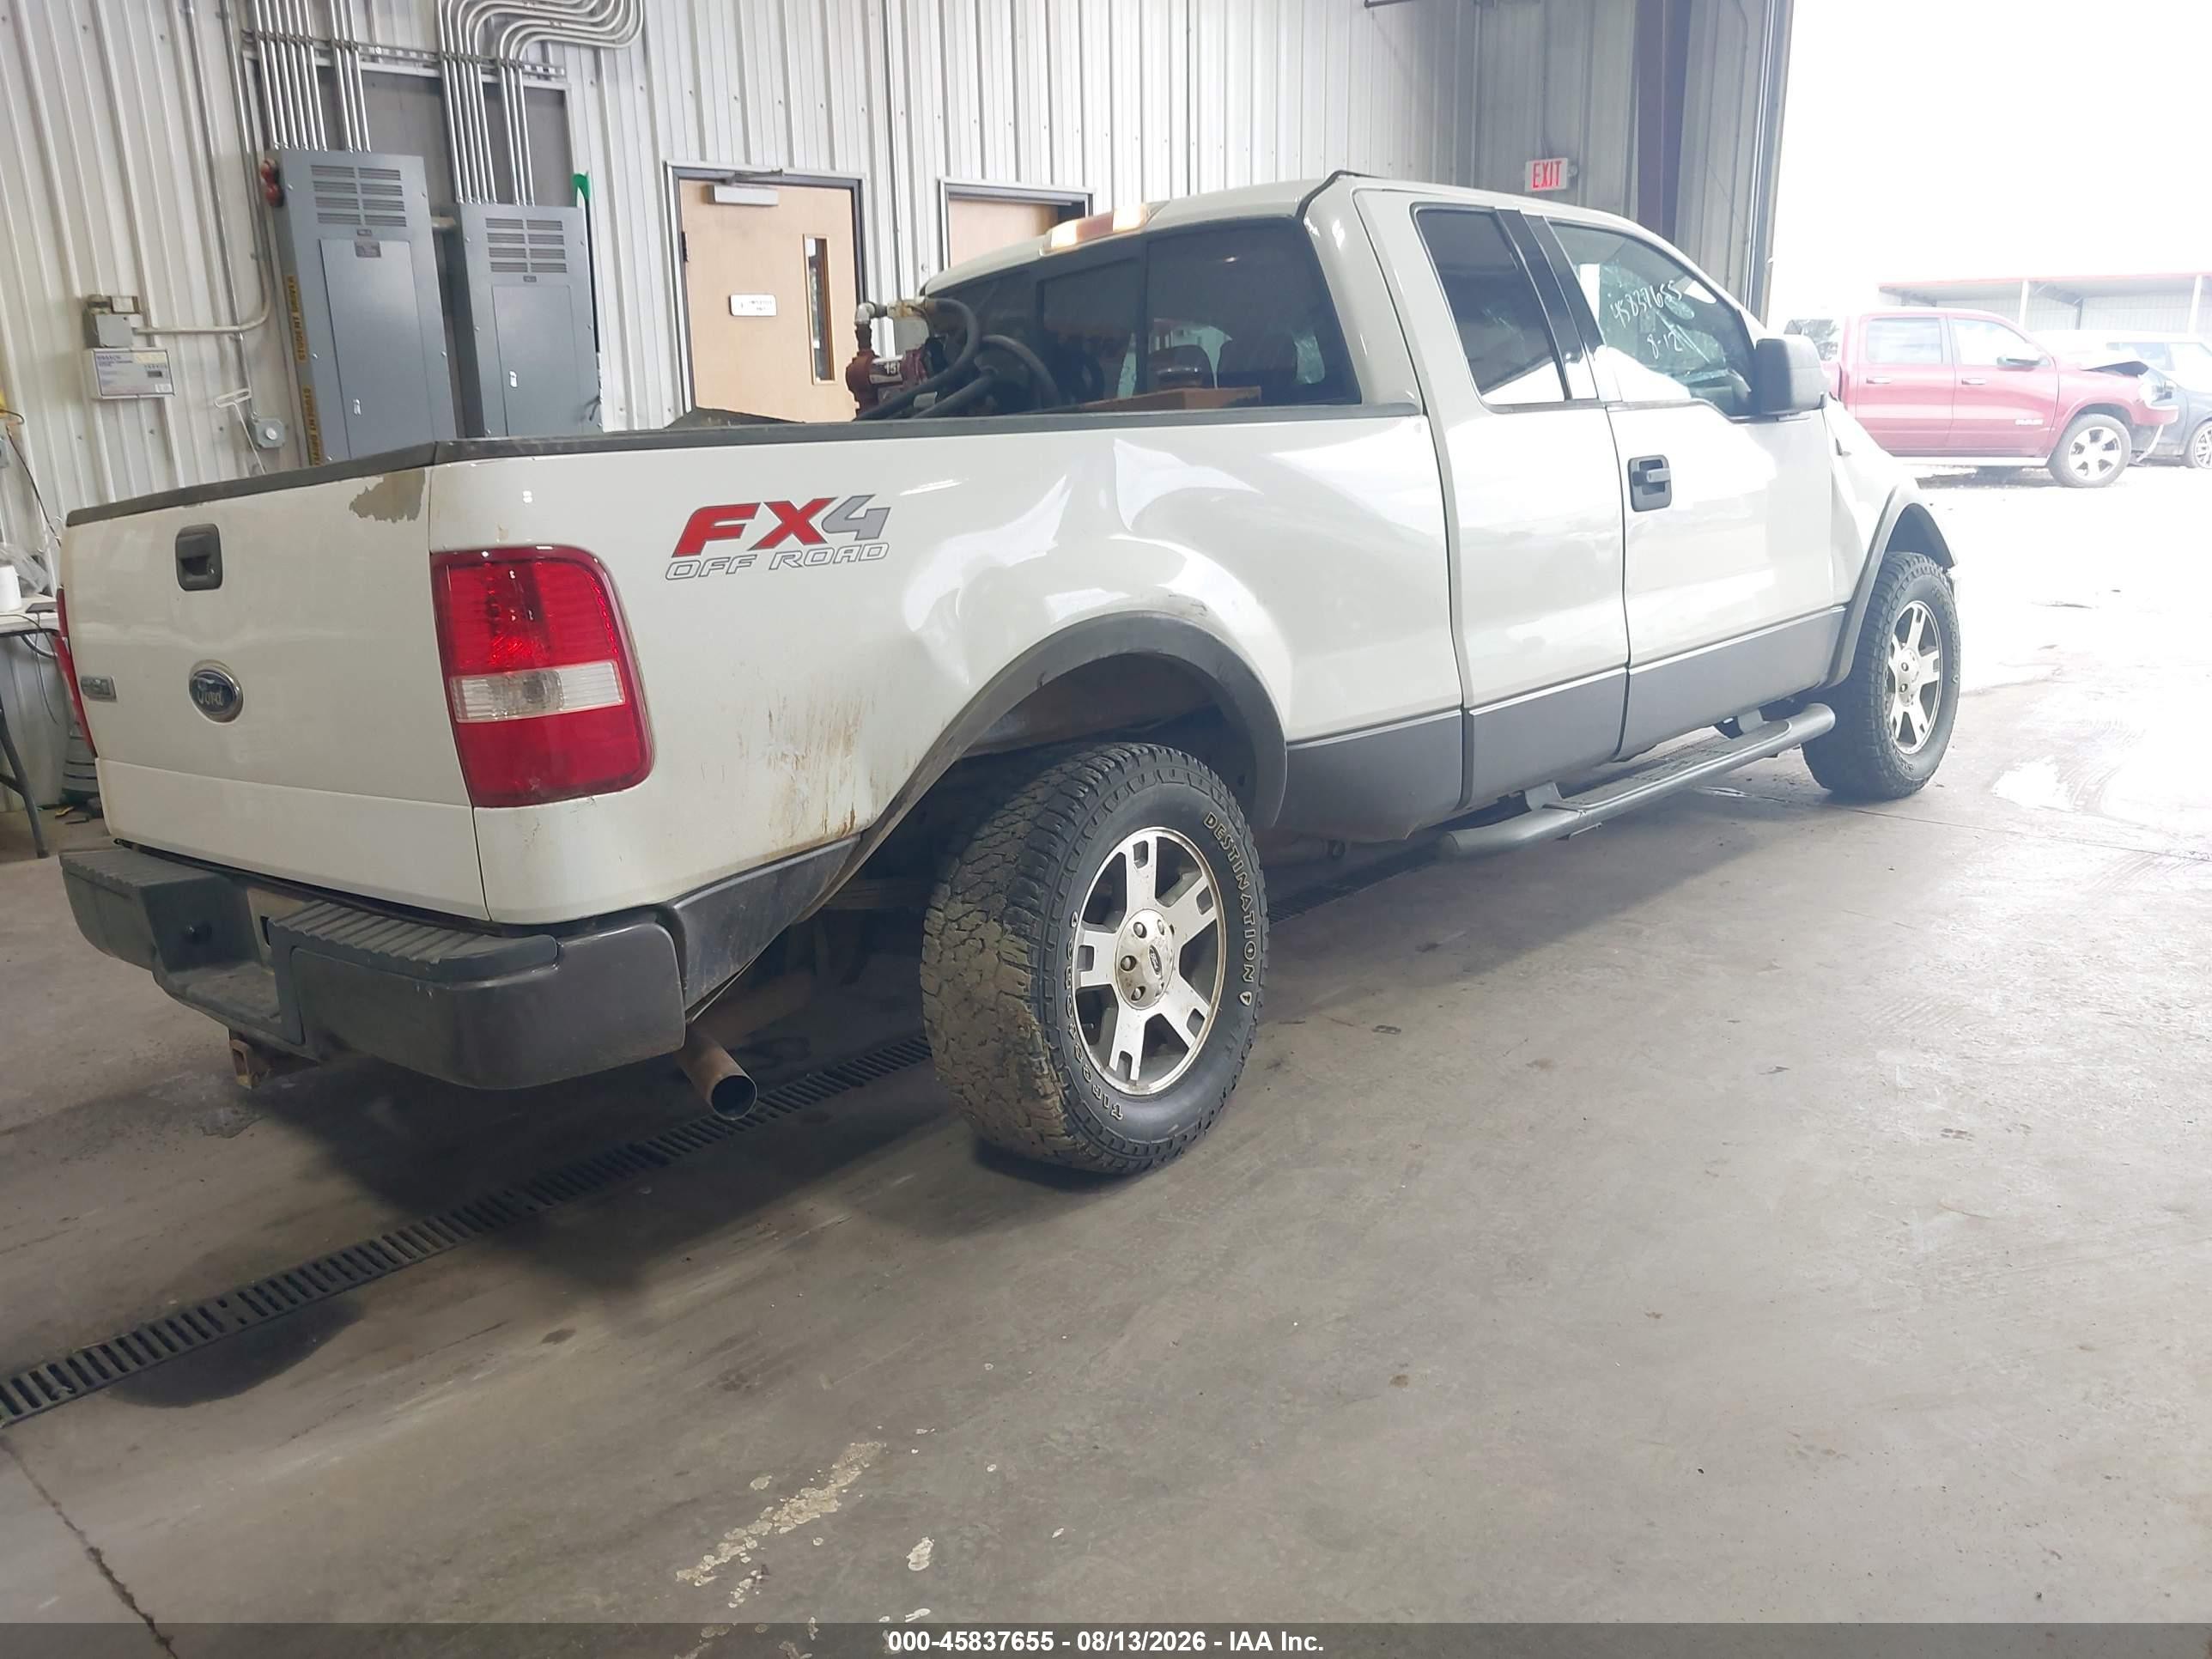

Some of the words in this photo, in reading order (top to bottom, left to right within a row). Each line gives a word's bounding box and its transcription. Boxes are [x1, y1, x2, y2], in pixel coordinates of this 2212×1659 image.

[1532, 161, 1562, 189] EXIT
[1610, 279, 1682, 329] 45837655
[672, 494, 891, 558] FX4
[665, 554, 757, 581] OFF
[768, 542, 890, 571] ROAD
[198, 678, 225, 707] Ford
[1203, 811, 1257, 983] DESTINATION
